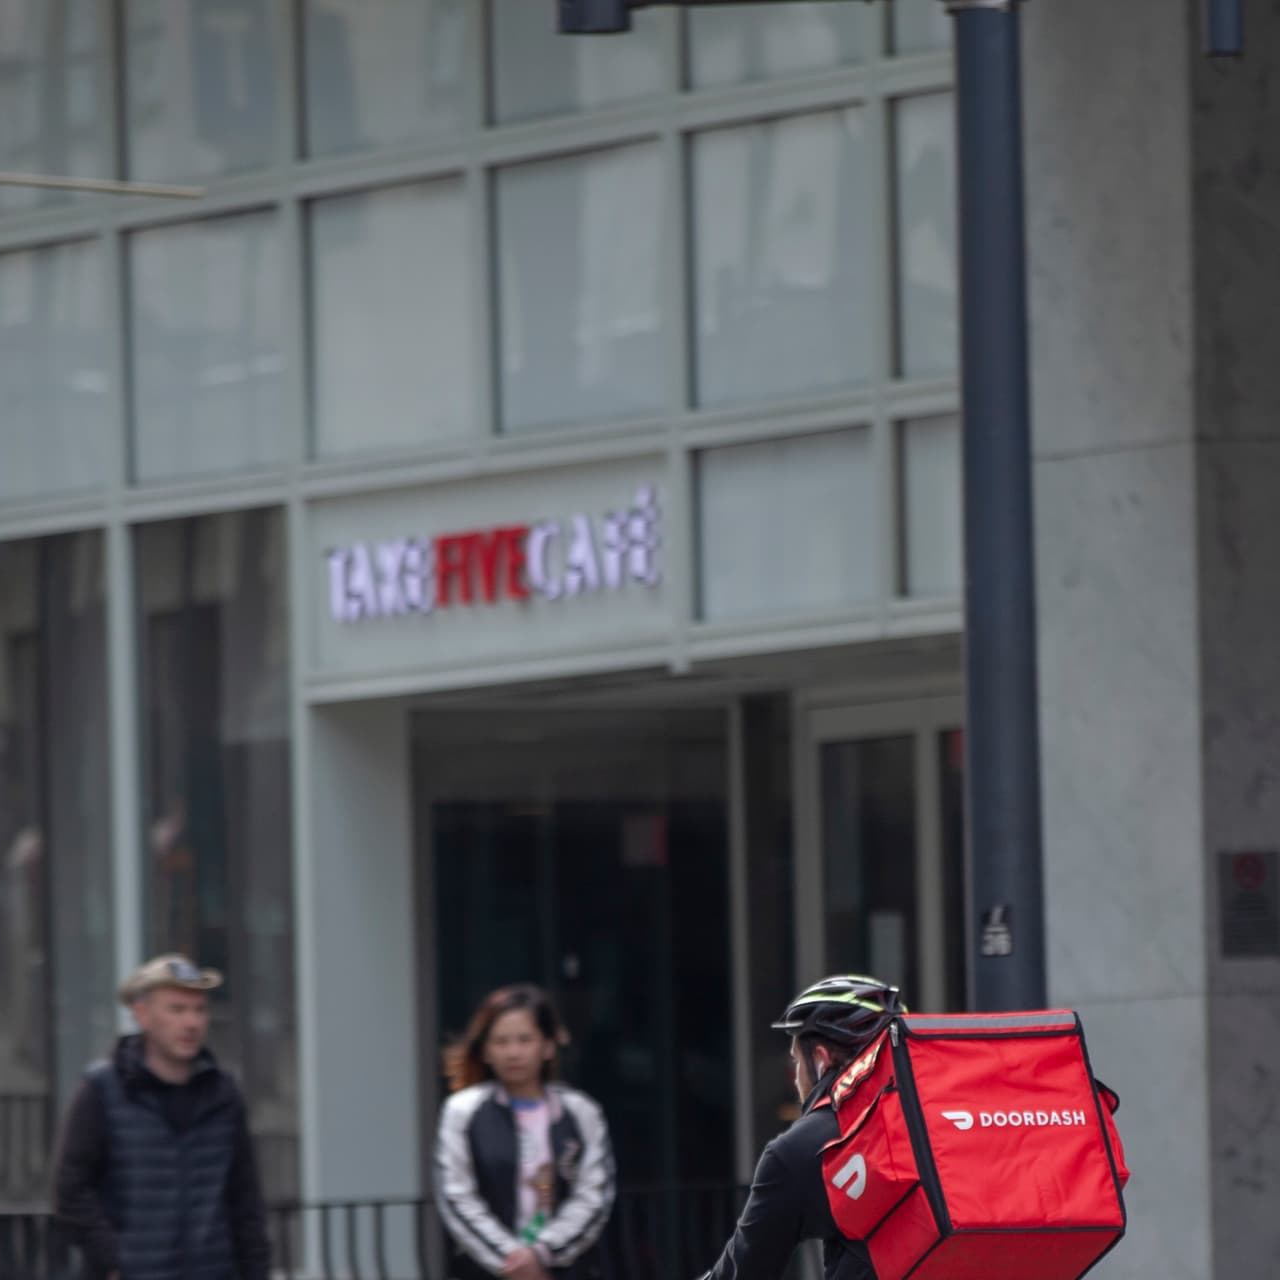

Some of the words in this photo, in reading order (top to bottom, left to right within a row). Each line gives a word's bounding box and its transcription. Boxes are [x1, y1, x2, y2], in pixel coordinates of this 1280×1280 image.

[328, 538, 434, 621] TAKE
[433, 525, 528, 608] FIVE
[979, 1110, 1086, 1127] DOORDASH
